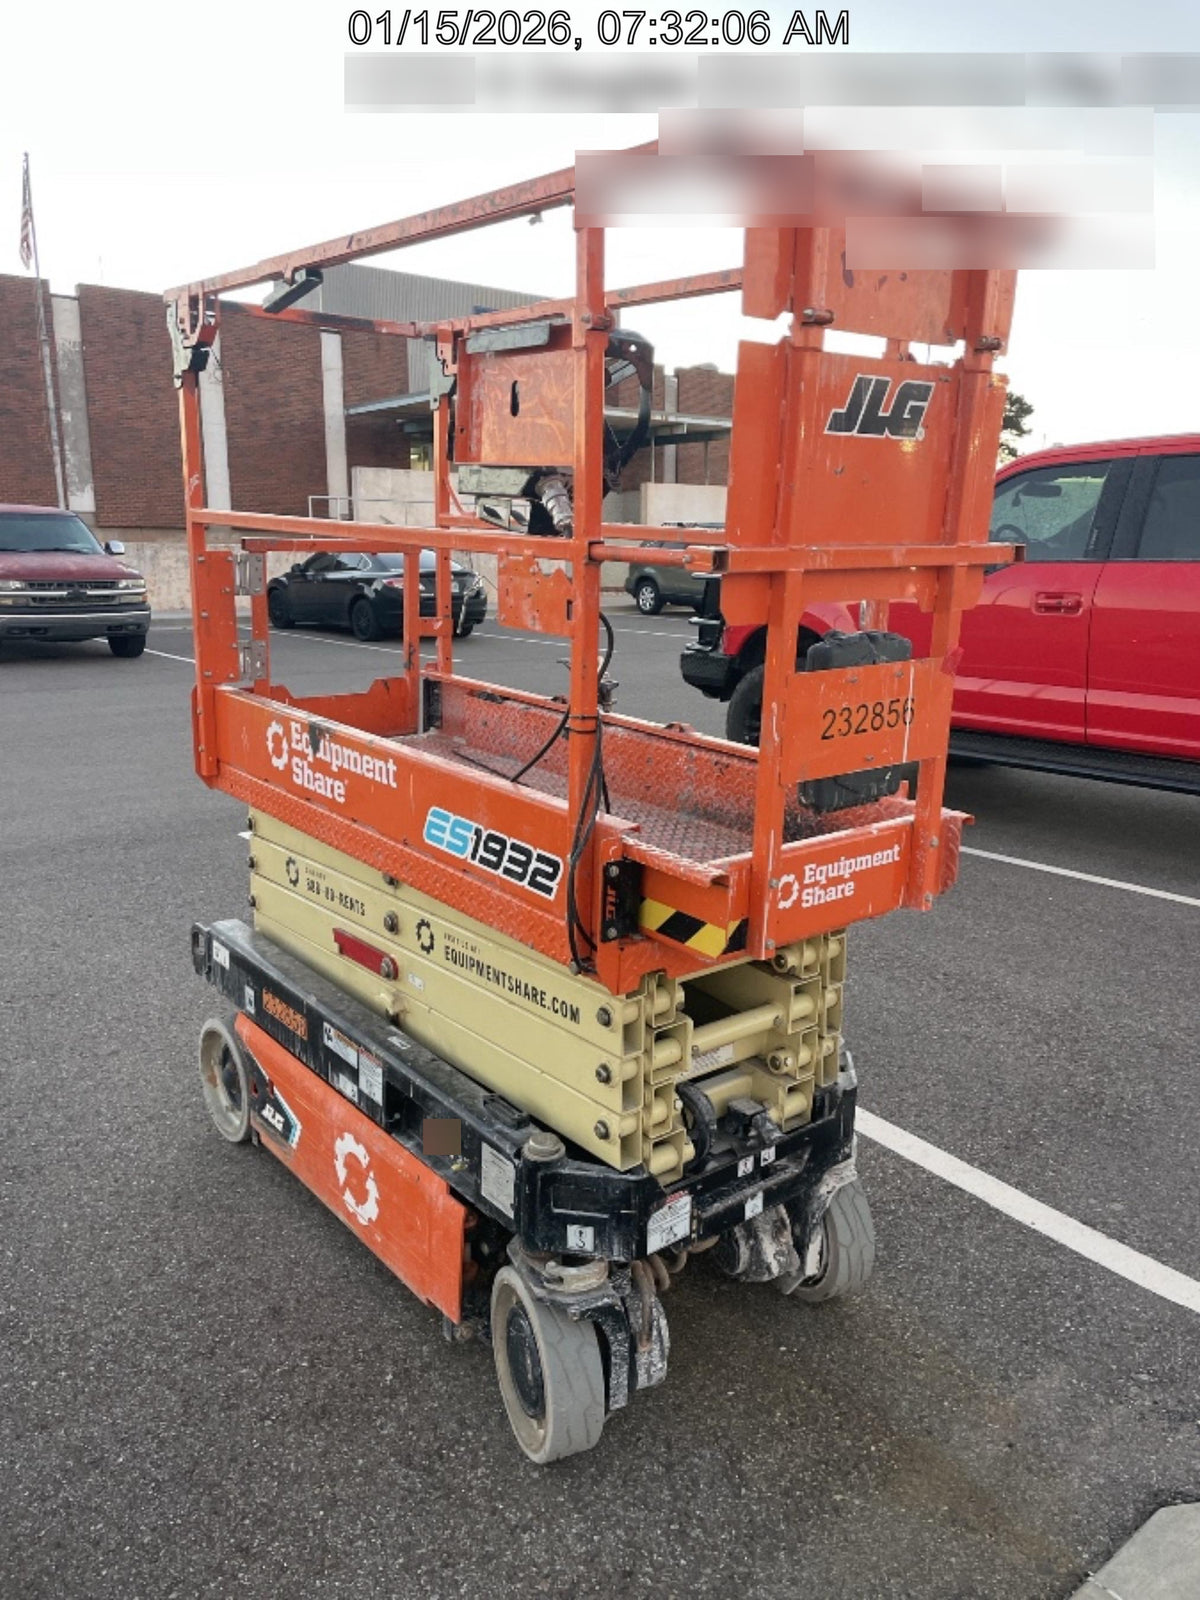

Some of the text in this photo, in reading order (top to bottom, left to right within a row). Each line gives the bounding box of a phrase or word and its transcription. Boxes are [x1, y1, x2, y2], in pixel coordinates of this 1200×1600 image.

[823, 373, 935, 440] JLG
[820, 697, 915, 741] 232856
[291, 755, 346, 803] Share
[424, 807, 563, 899] ES1932
[803, 844, 901, 885] Equipment
[801, 881, 855, 908] Share
[443, 945, 581, 1025] EQUIPMENTSHARE.COM
